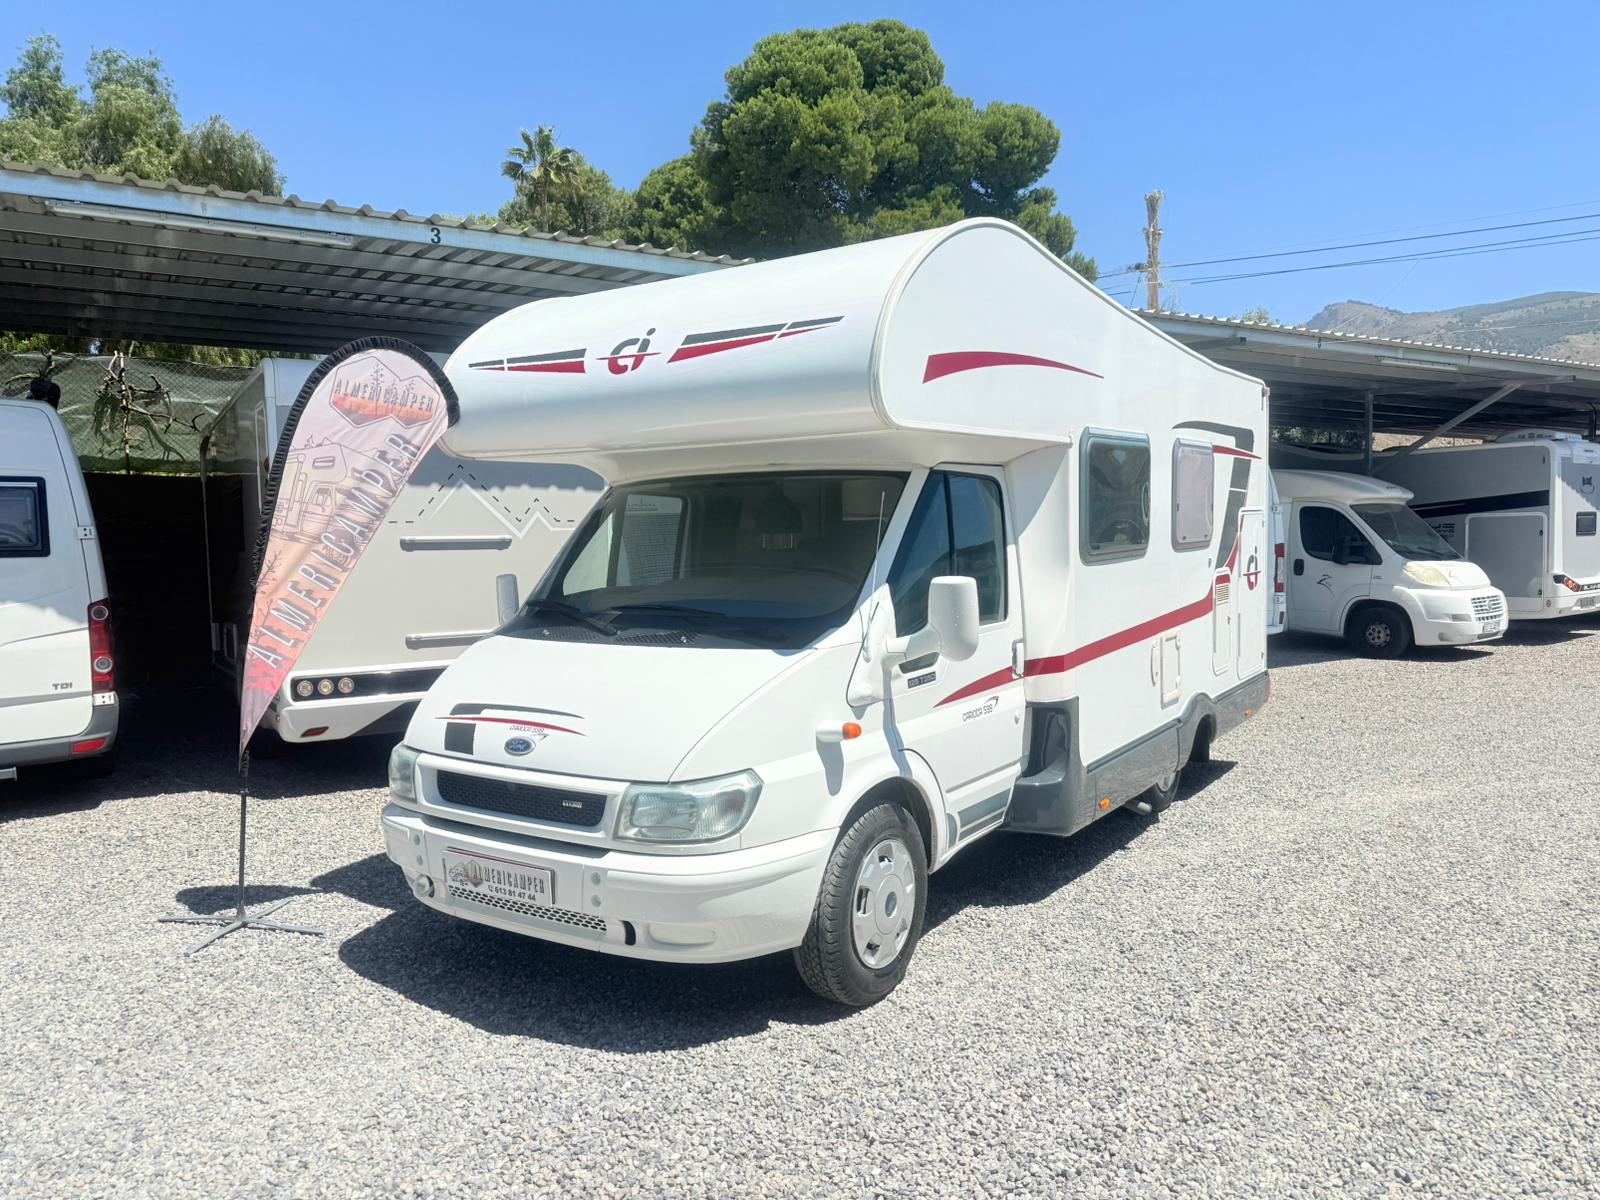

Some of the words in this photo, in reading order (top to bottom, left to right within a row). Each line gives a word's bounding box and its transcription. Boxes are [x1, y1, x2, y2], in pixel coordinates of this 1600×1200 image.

[430, 227, 441, 244] 3
[333, 378, 435, 413] ALMERICAMPER
[247, 432, 421, 669] ALMERICAMPER
[52, 682, 73, 690] TDI
